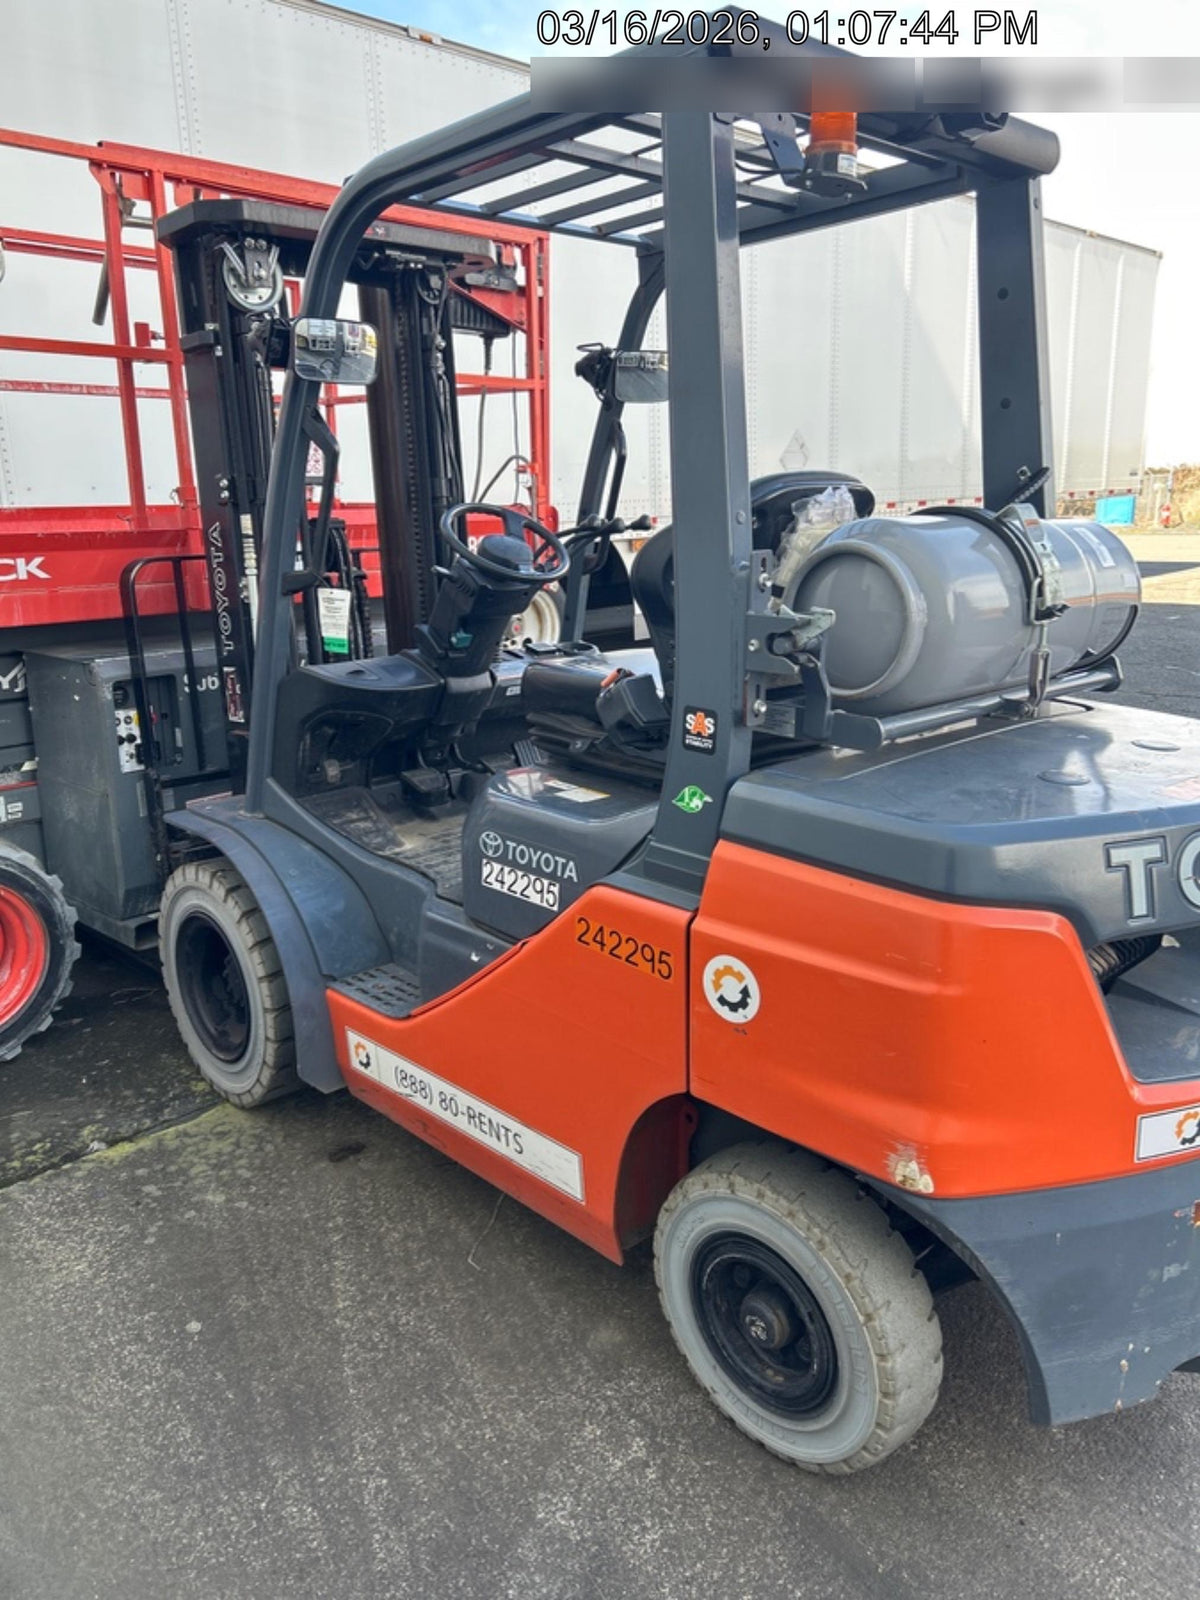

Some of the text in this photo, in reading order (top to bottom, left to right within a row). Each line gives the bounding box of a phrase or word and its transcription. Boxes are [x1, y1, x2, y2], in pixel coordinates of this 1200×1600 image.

[207, 521, 235, 656] TOYOTA
[685, 711, 715, 736] SAS
[483, 861, 557, 908] 242295
[505, 840, 578, 882] TOYOTA
[576, 916, 673, 980] 242295
[394, 1065, 524, 1155] (888) 80-RENTS
